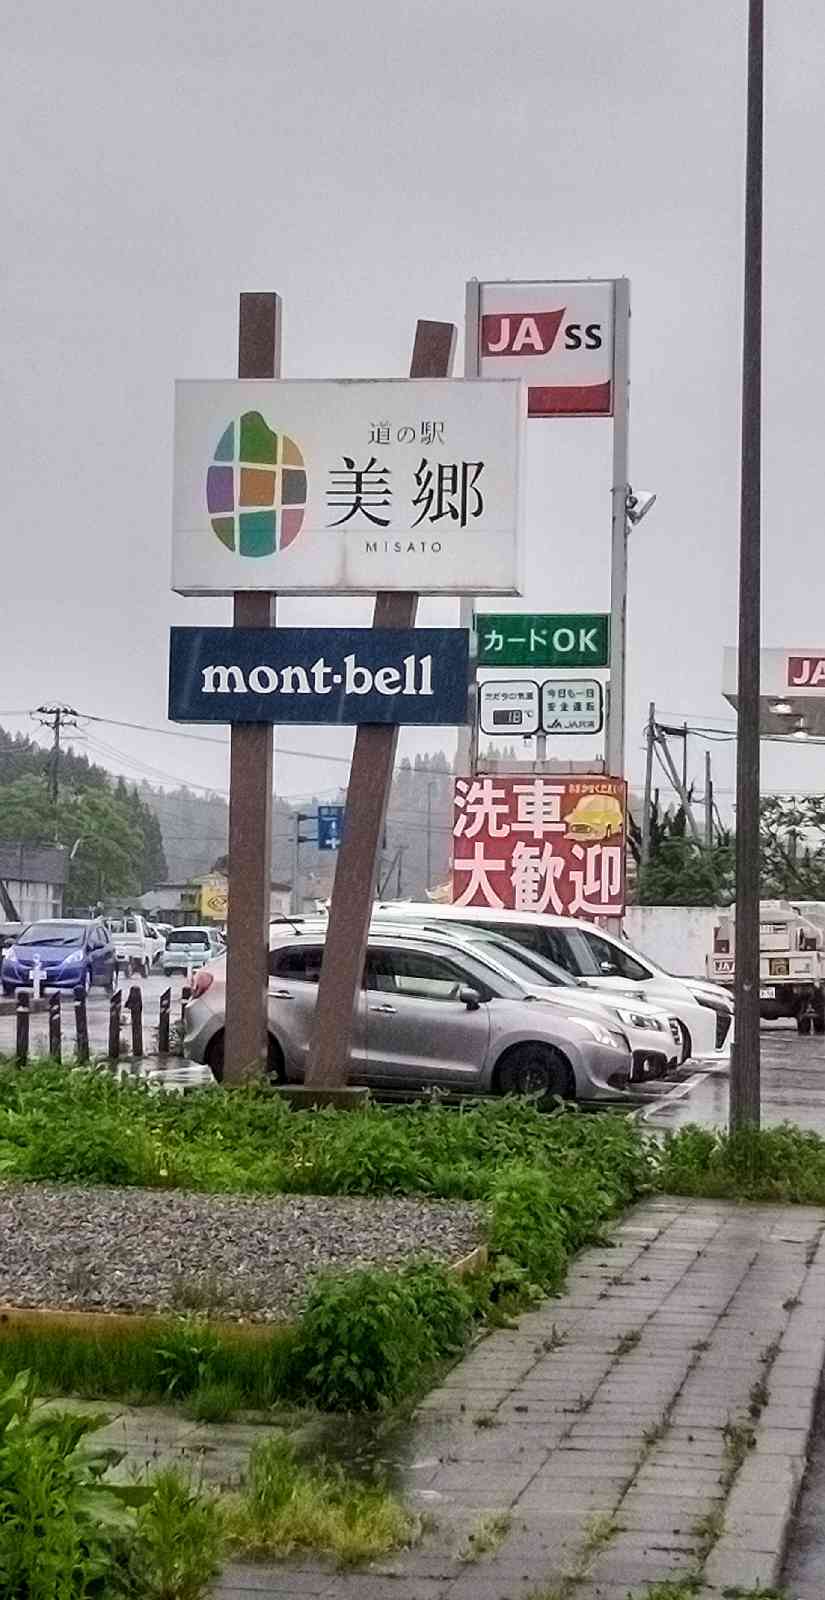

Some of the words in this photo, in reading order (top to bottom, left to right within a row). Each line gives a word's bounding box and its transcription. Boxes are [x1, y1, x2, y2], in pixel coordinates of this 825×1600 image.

[488, 317, 544, 352] JA
[565, 324, 602, 350] SS
[368, 421, 445, 445] 道の駅
[325, 456, 485, 528] 美郷
[366, 541, 442, 553] MISATO
[484, 628, 598, 652] カードOK
[793, 660, 825, 684] JA
[453, 779, 566, 839] 洗車
[453, 841, 623, 915] 大歓迎
